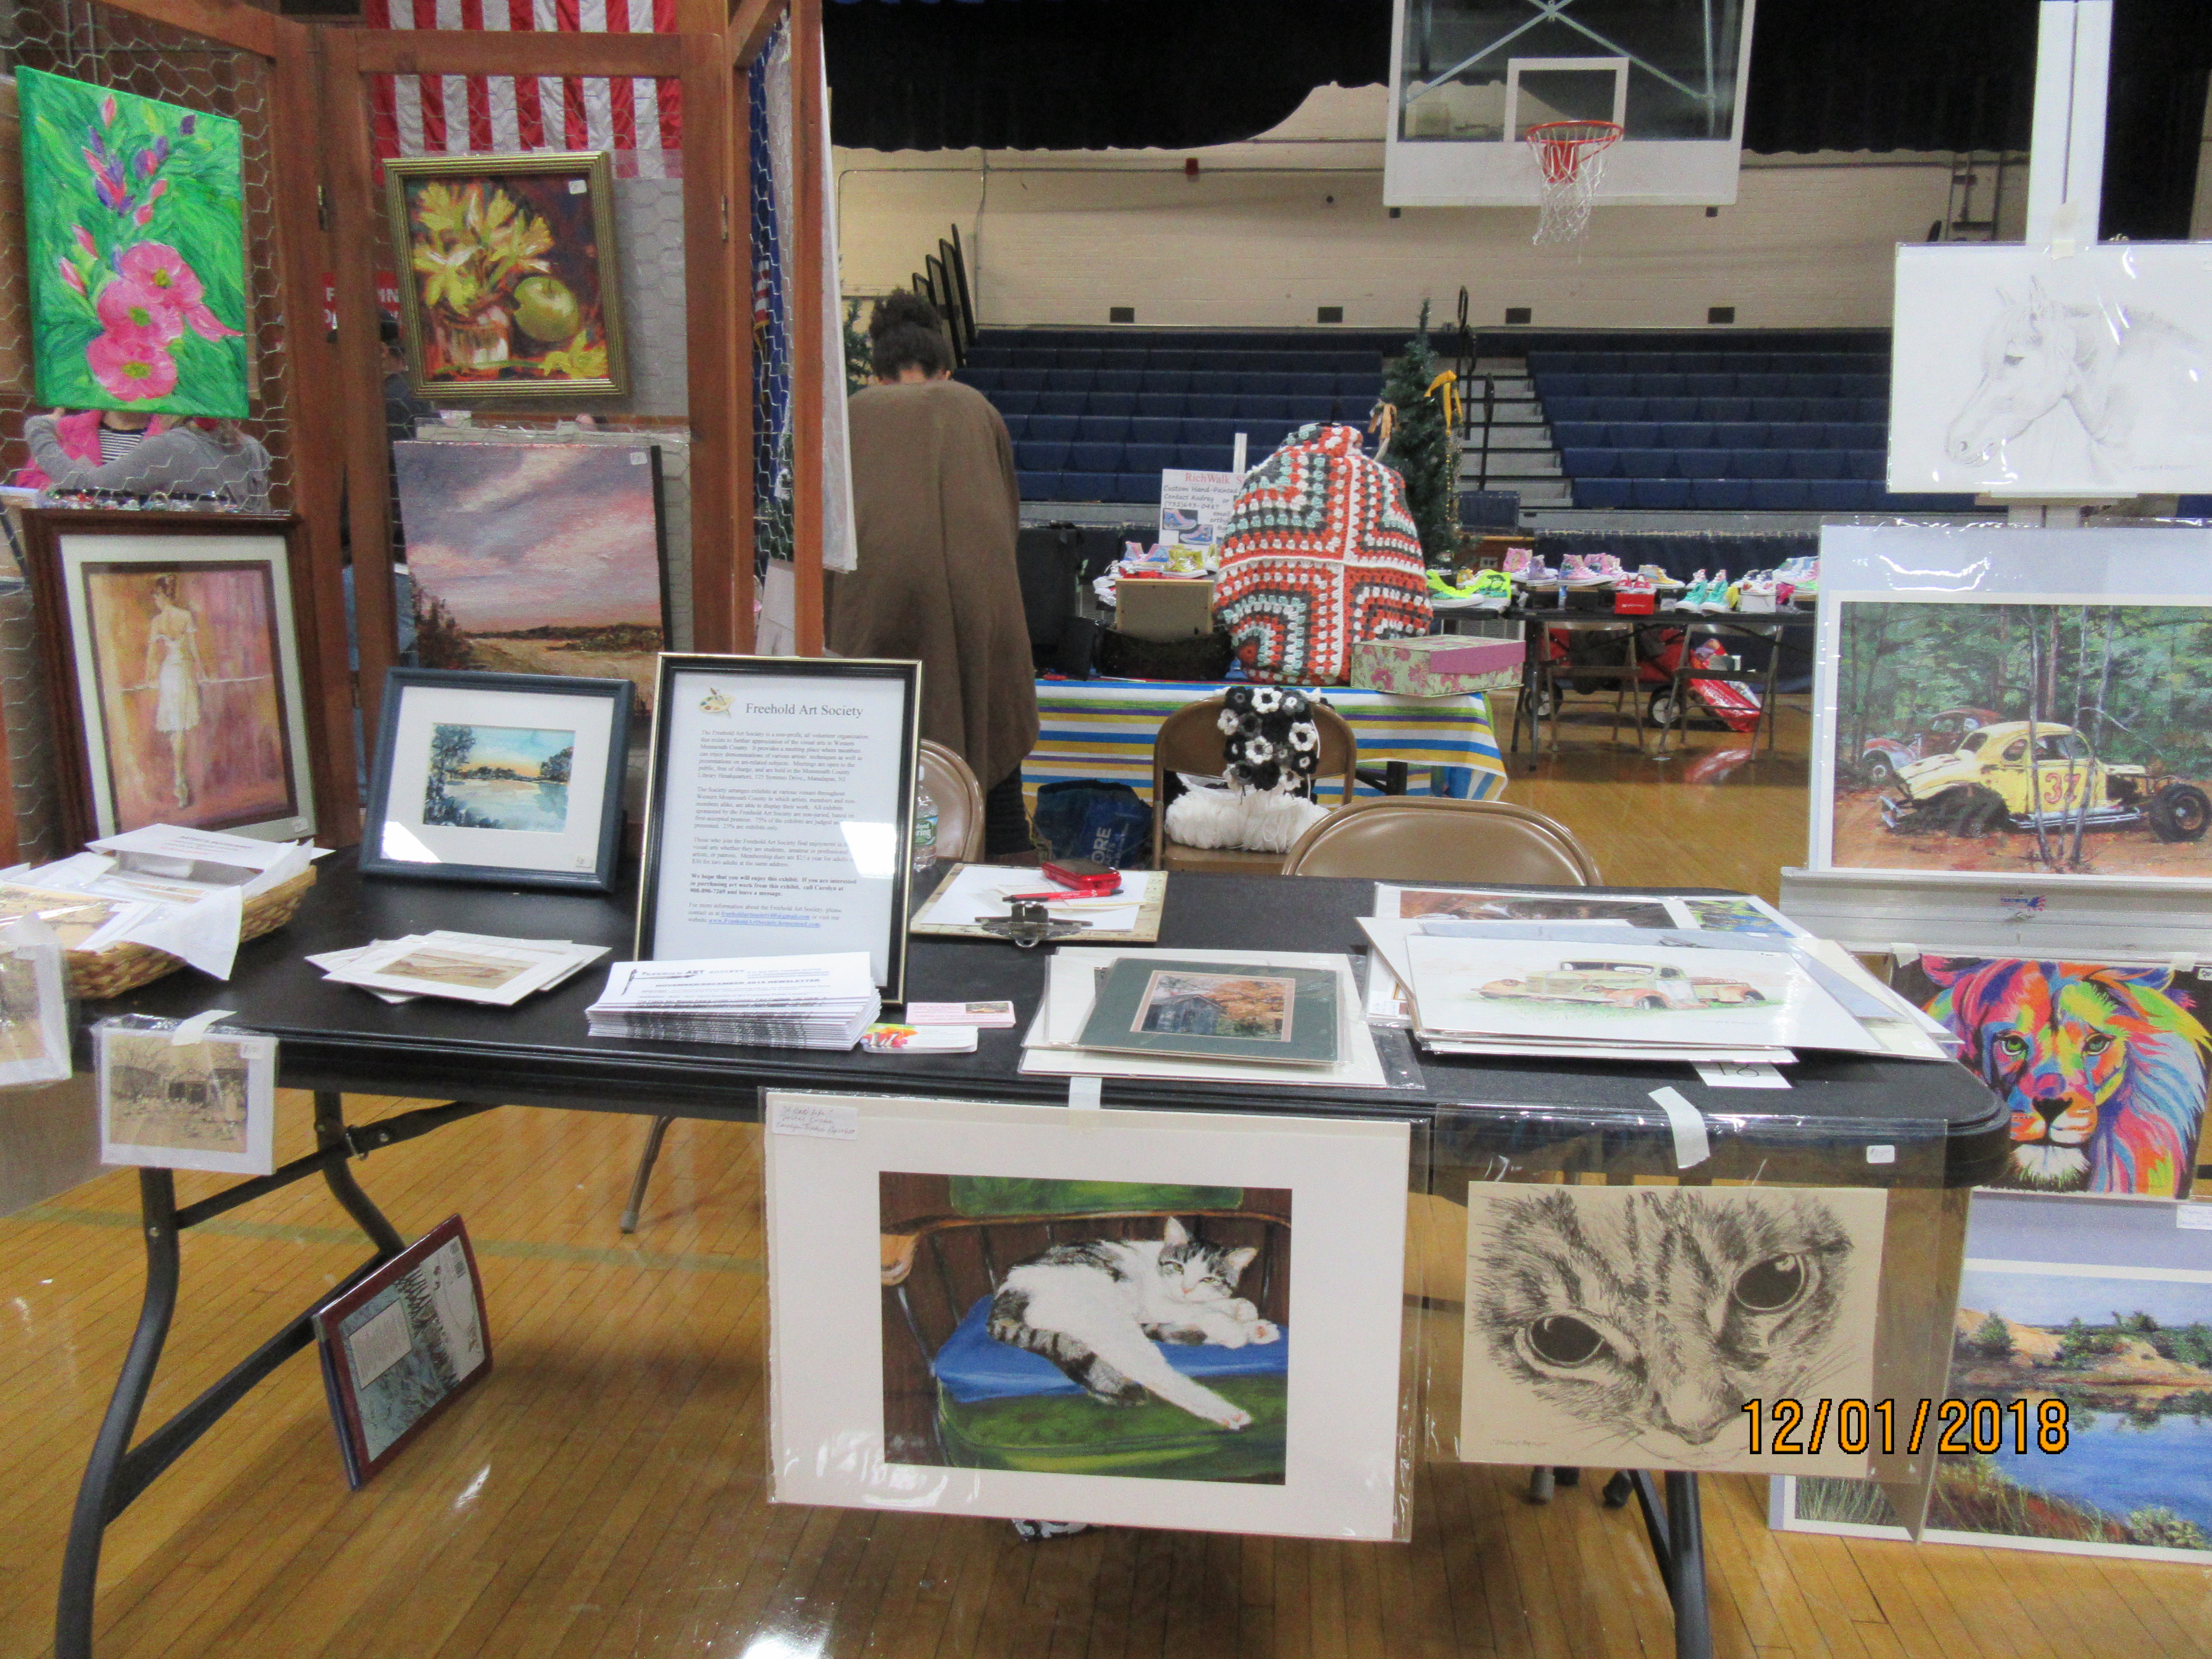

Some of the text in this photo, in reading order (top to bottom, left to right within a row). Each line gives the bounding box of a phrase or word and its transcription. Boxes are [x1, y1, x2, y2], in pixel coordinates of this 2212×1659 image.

[1185, 472, 1230, 484] RichWalk
[746, 703, 864, 719] Freehold Art Society
